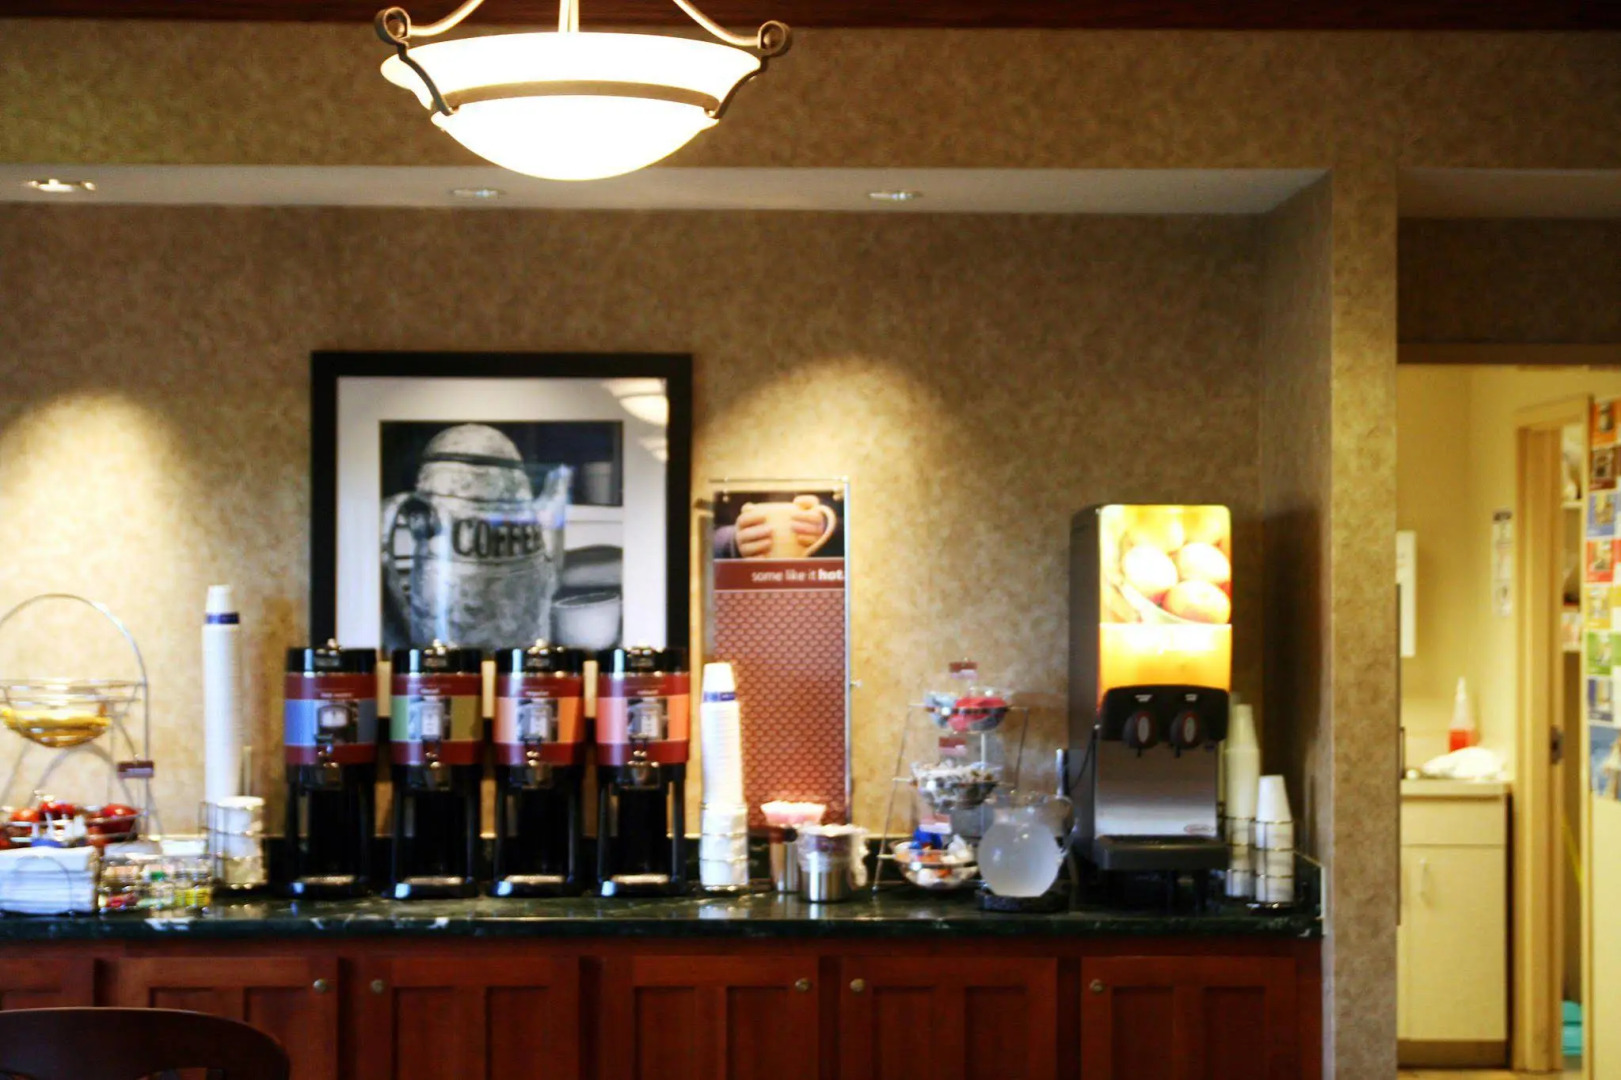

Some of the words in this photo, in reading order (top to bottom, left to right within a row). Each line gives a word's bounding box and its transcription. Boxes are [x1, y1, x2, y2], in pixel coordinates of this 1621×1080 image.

[752, 571, 783, 582] some
[785, 569, 806, 581] like
[808, 569, 817, 581] it
